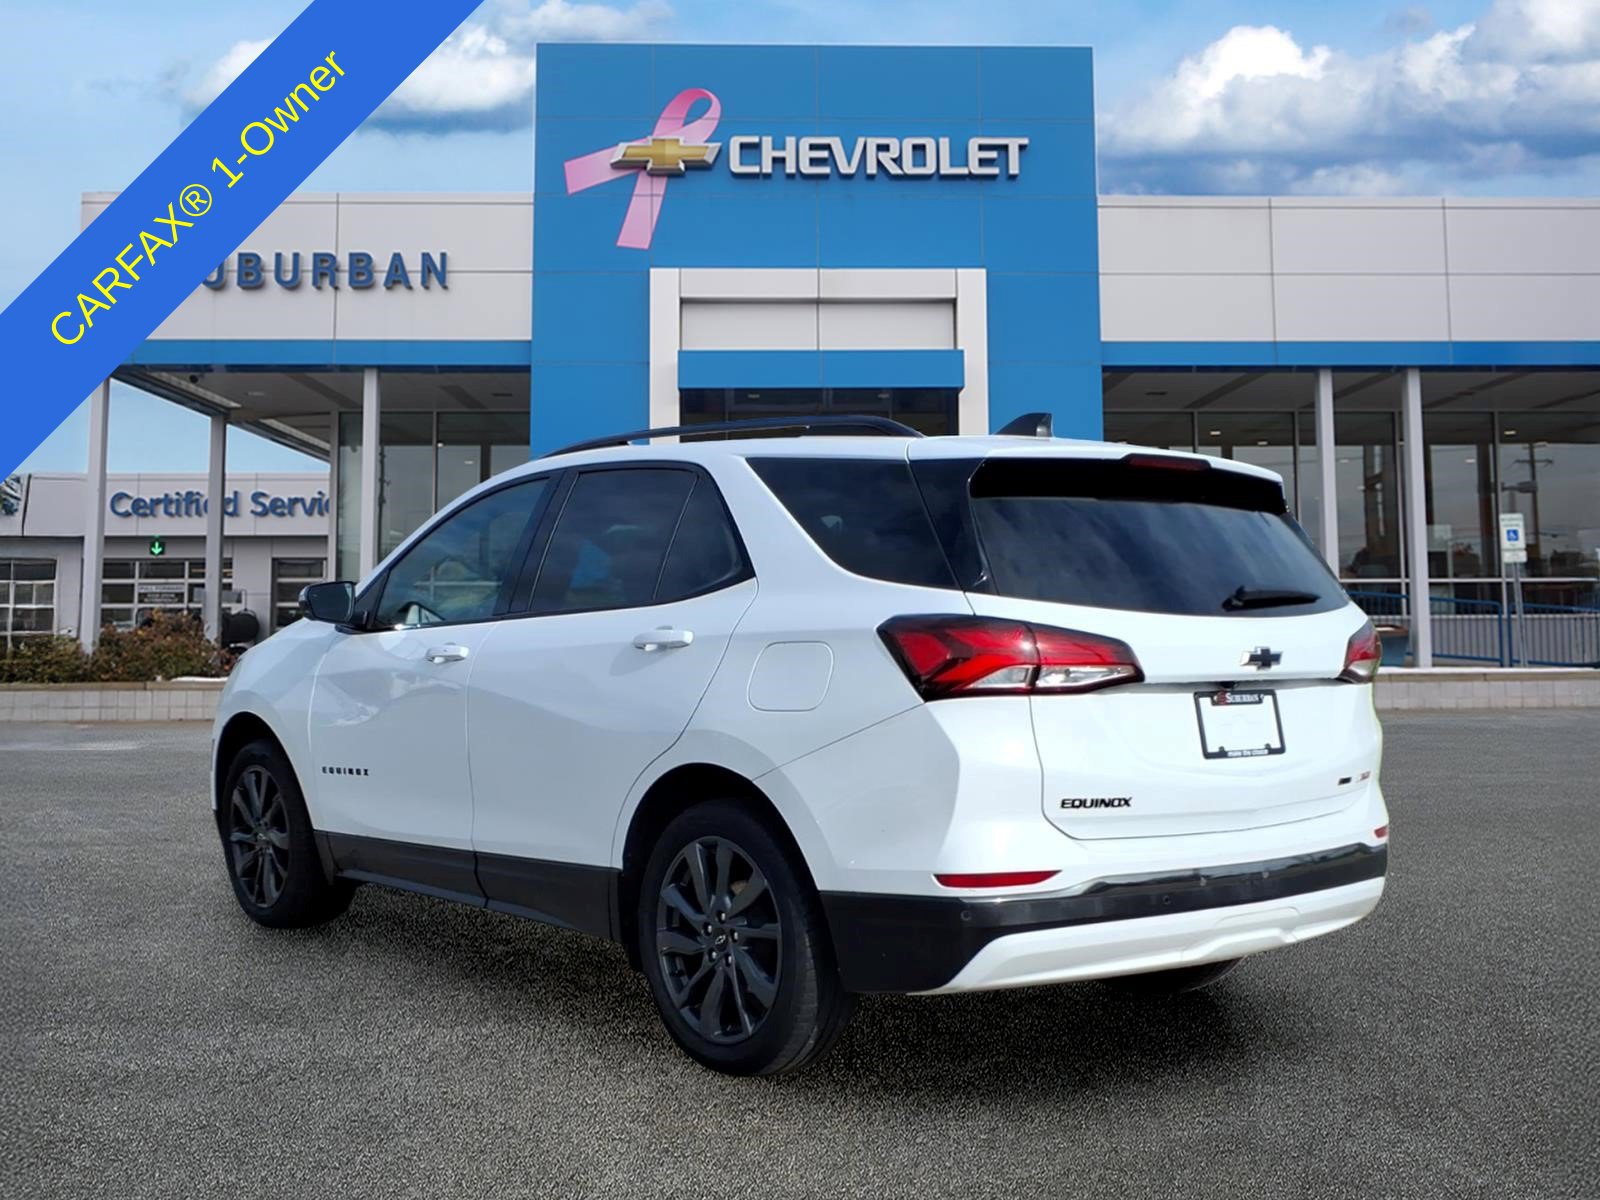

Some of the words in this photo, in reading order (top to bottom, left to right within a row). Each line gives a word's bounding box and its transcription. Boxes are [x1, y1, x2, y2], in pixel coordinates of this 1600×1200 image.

[729, 135, 1029, 176] CHEVROLET
[203, 252, 448, 290] UBURBAN
[110, 491, 239, 518] Certifid
[250, 491, 330, 517] Servi
[1060, 797, 1133, 809] EQUINOX
